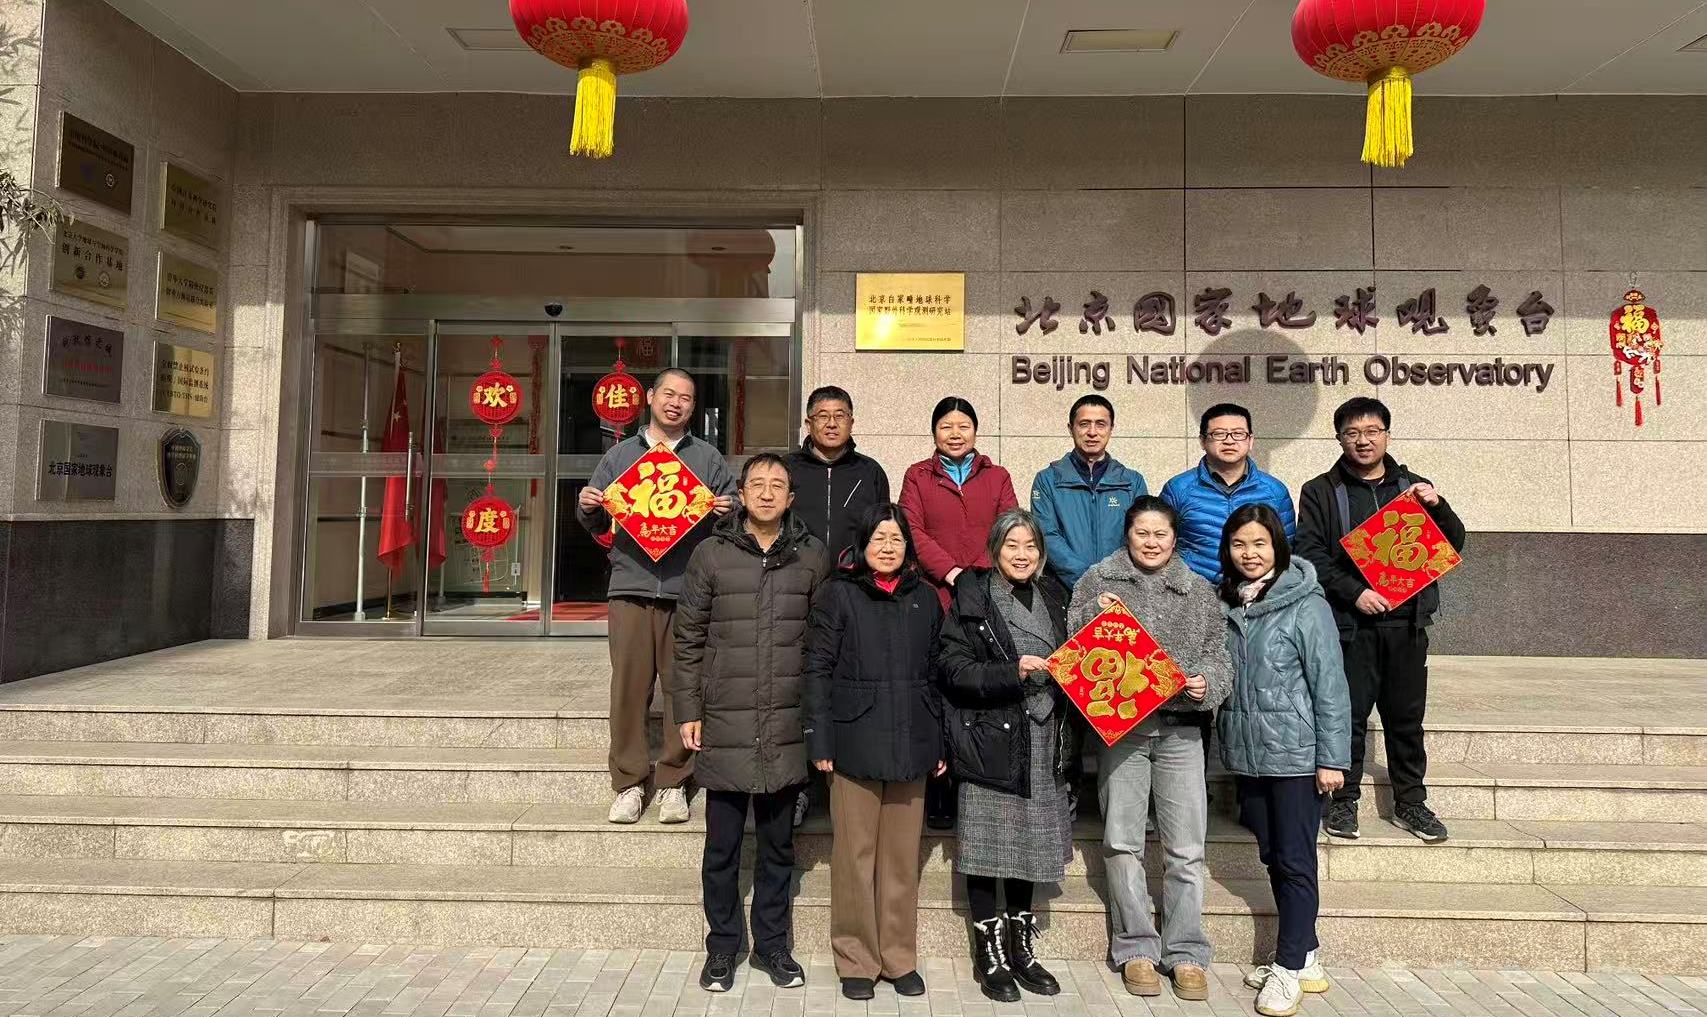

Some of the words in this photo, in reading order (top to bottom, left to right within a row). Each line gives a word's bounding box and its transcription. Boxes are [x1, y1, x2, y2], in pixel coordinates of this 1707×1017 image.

[62, 242, 123, 271] 创新合作基地
[1014, 283, 1555, 337] 北京国家地球观象台
[1620, 304, 1650, 334] 福
[1011, 355, 1110, 391] Beijing
[1126, 355, 1250, 385] National
[1266, 355, 1349, 386] Earth
[1364, 355, 1554, 393] Observatory
[482, 382, 508, 408] 欢
[604, 383, 630, 409] 佳
[48, 461, 112, 478] 北京国家地球观象台
[628, 461, 688, 519] 福
[474, 507, 500, 534] 度
[1371, 510, 1429, 571] 福
[1080, 647, 1150, 720] 福
